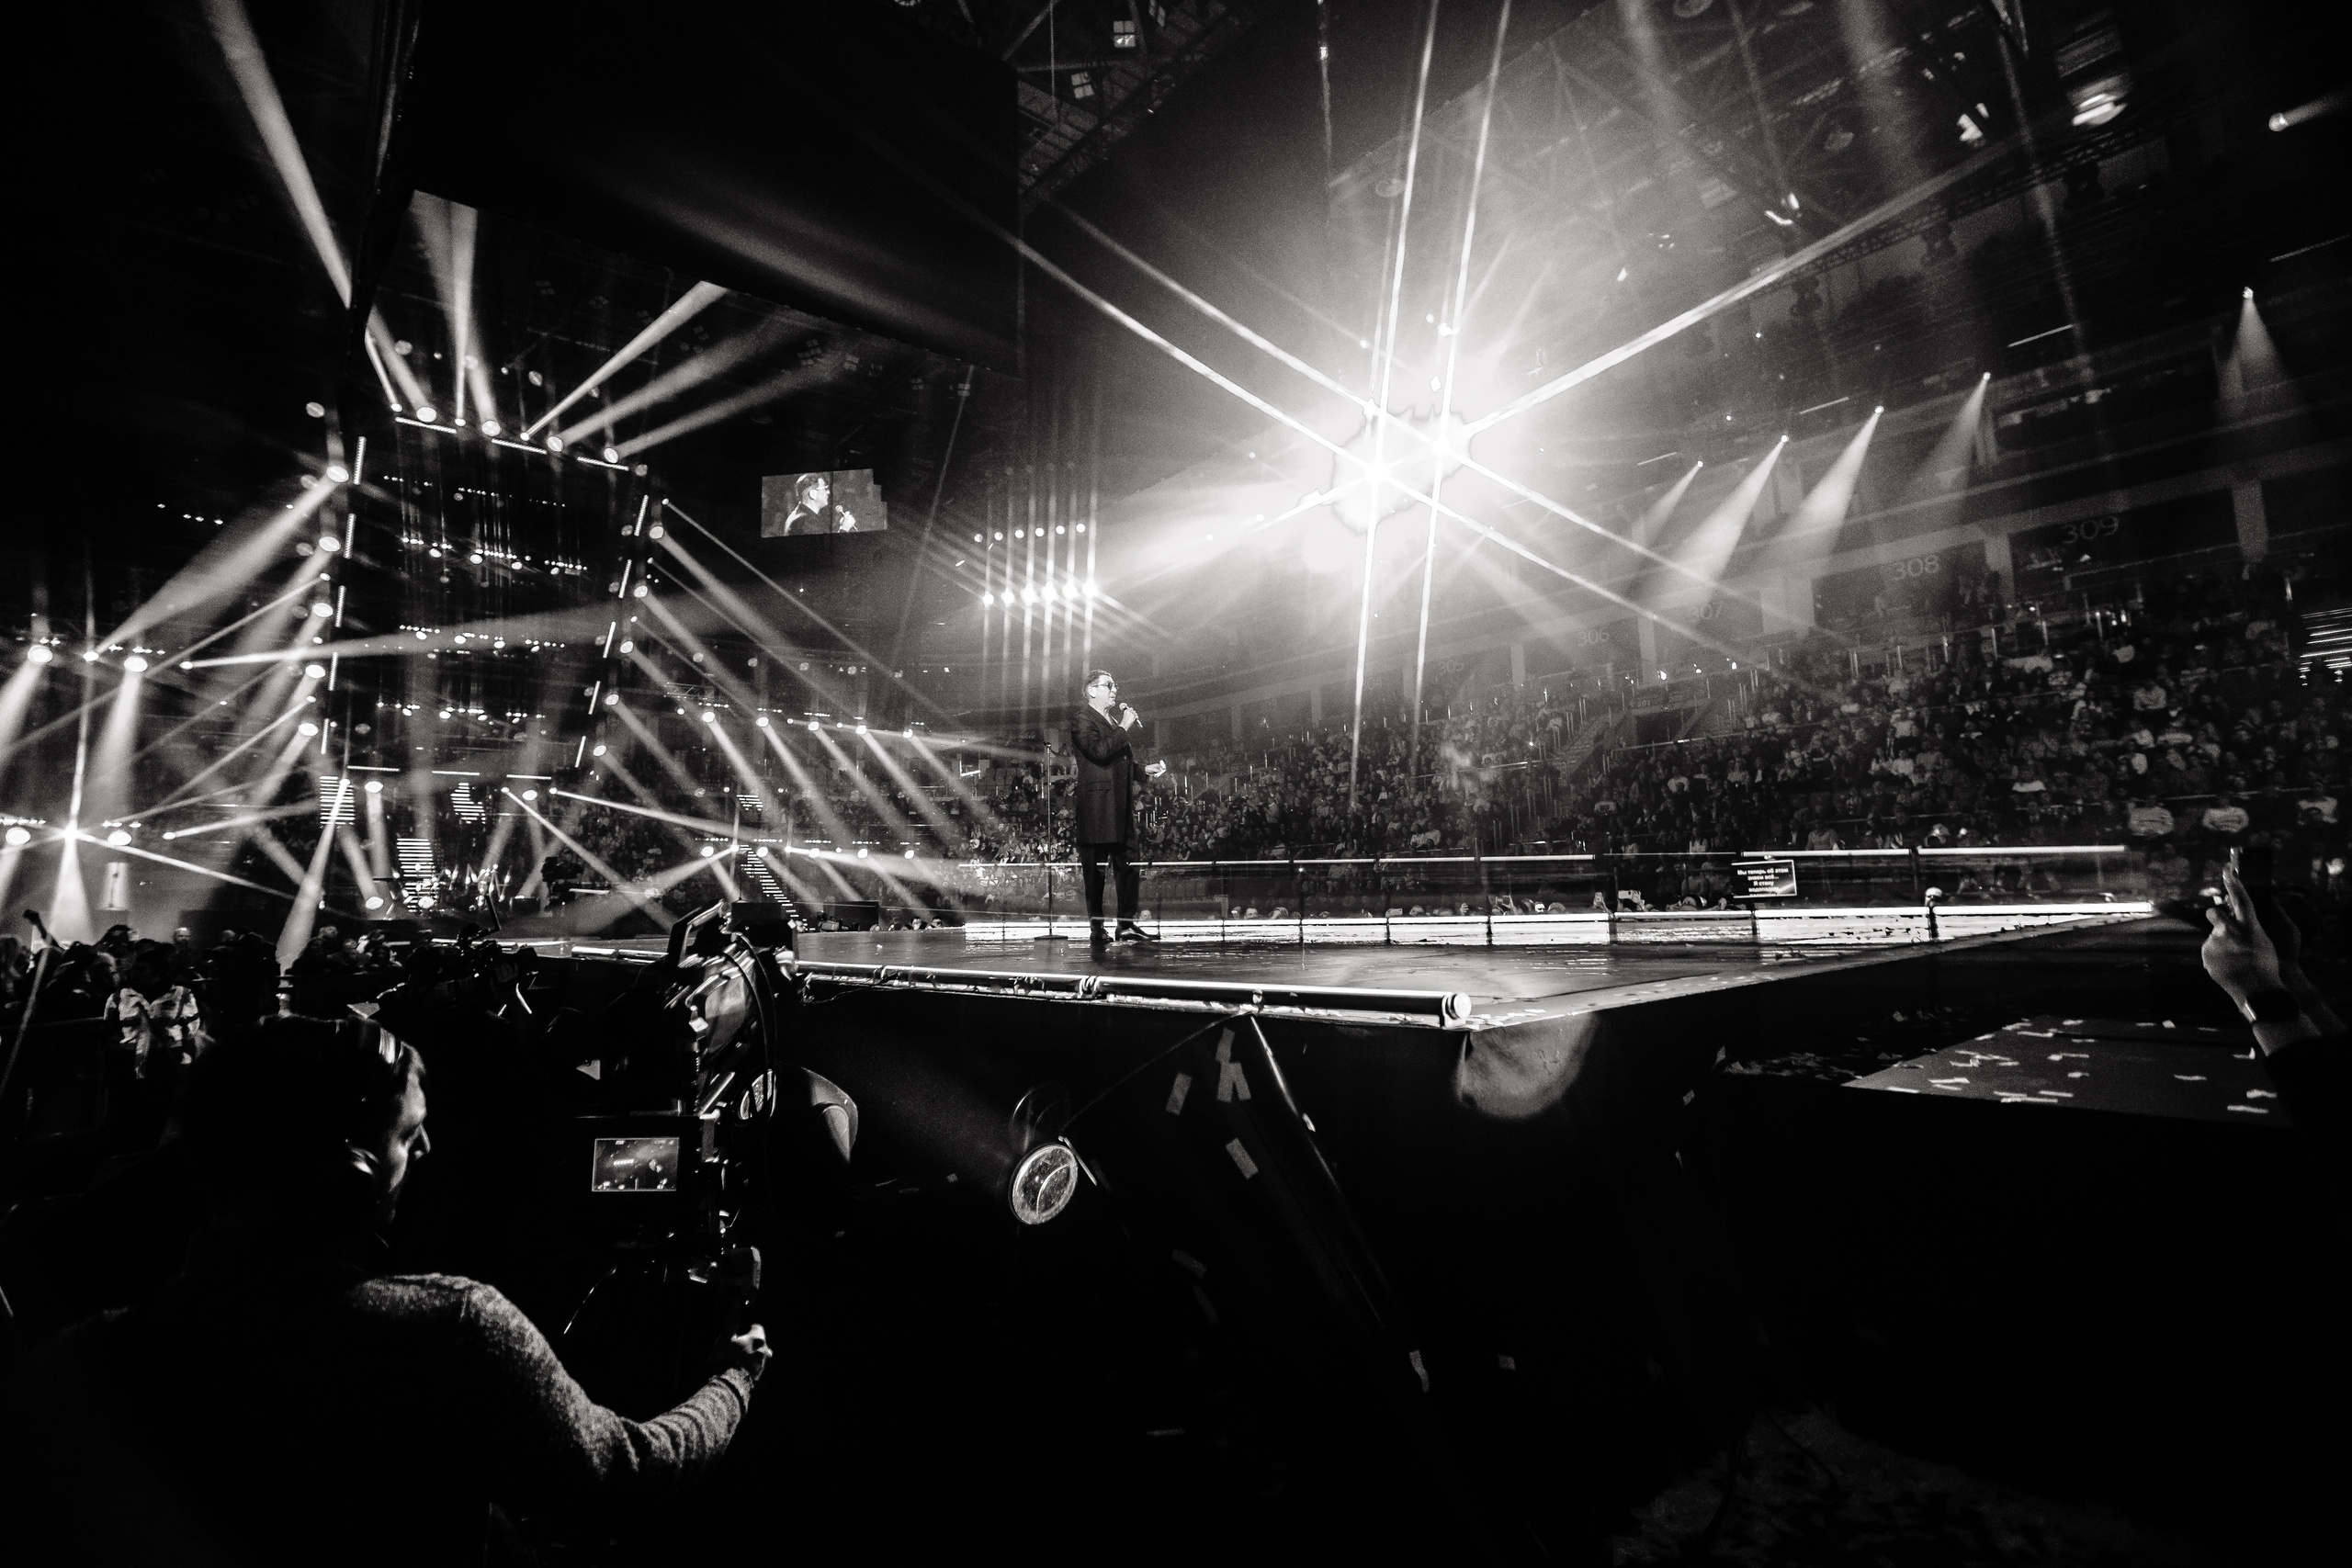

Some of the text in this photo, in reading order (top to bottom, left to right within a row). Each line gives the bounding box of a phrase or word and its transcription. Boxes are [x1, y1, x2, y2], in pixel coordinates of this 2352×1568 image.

[2061, 516, 2119, 545] 309
[1892, 554, 1939, 581] 308
[1687, 601, 1724, 623] 307
[1577, 626, 1610, 647] 306
